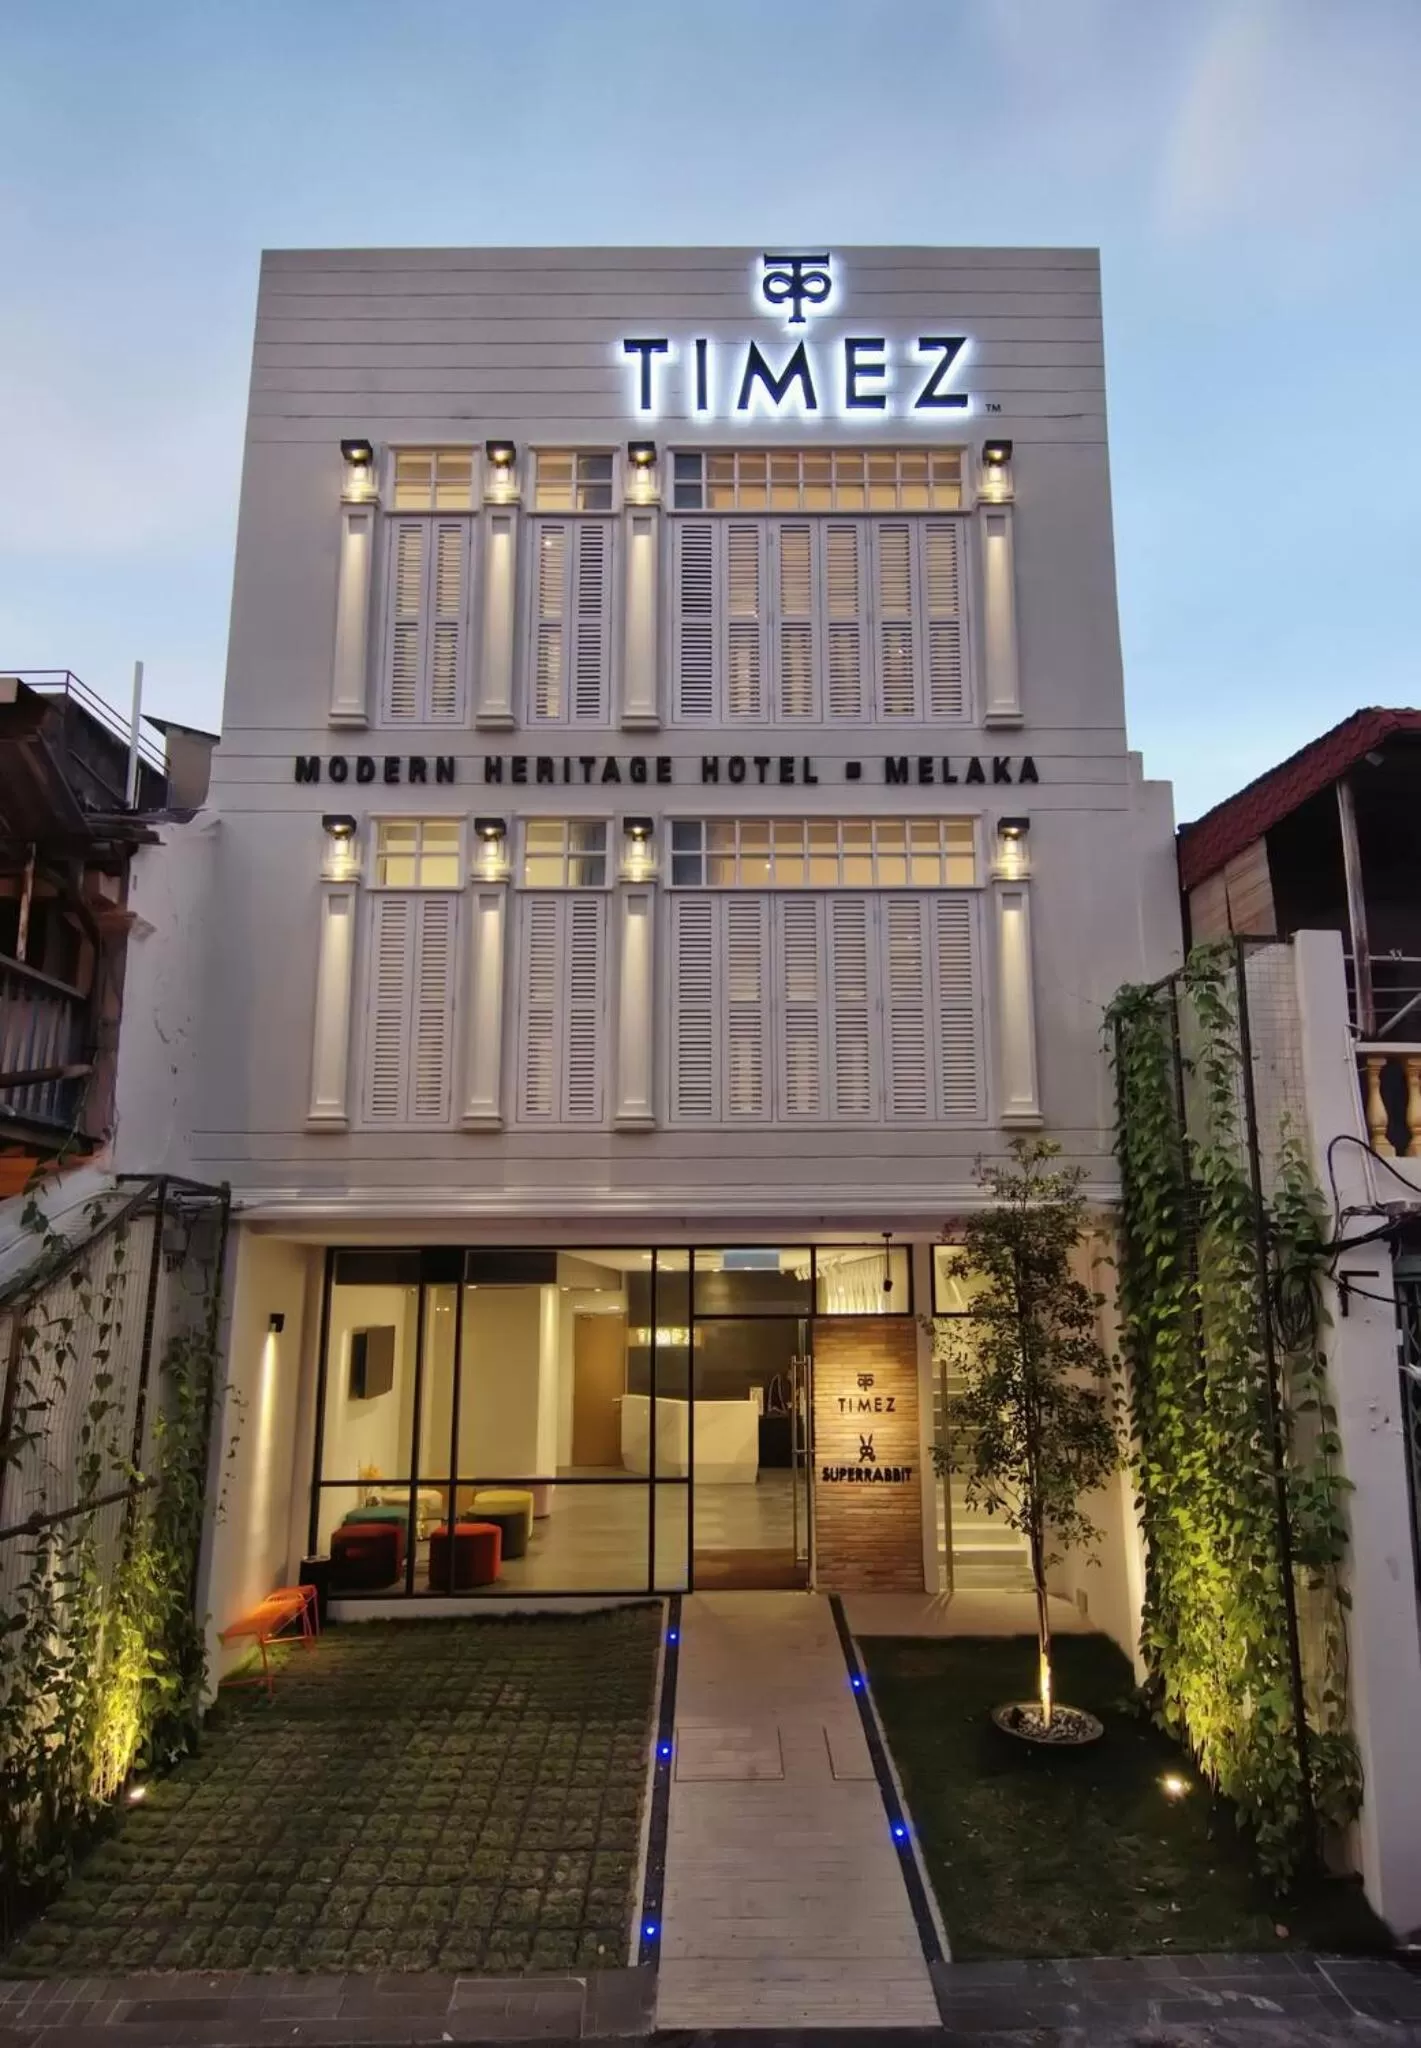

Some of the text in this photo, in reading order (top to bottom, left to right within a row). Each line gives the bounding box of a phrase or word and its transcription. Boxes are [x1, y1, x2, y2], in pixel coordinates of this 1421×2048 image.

[623, 336, 969, 410] TIMEZ
[295, 756, 1039, 783] MODERN HERITAGE HOTEL MELAKA
[838, 1397, 896, 1413] TIMEZ
[822, 1467, 912, 1483] SUPERRABBIT
